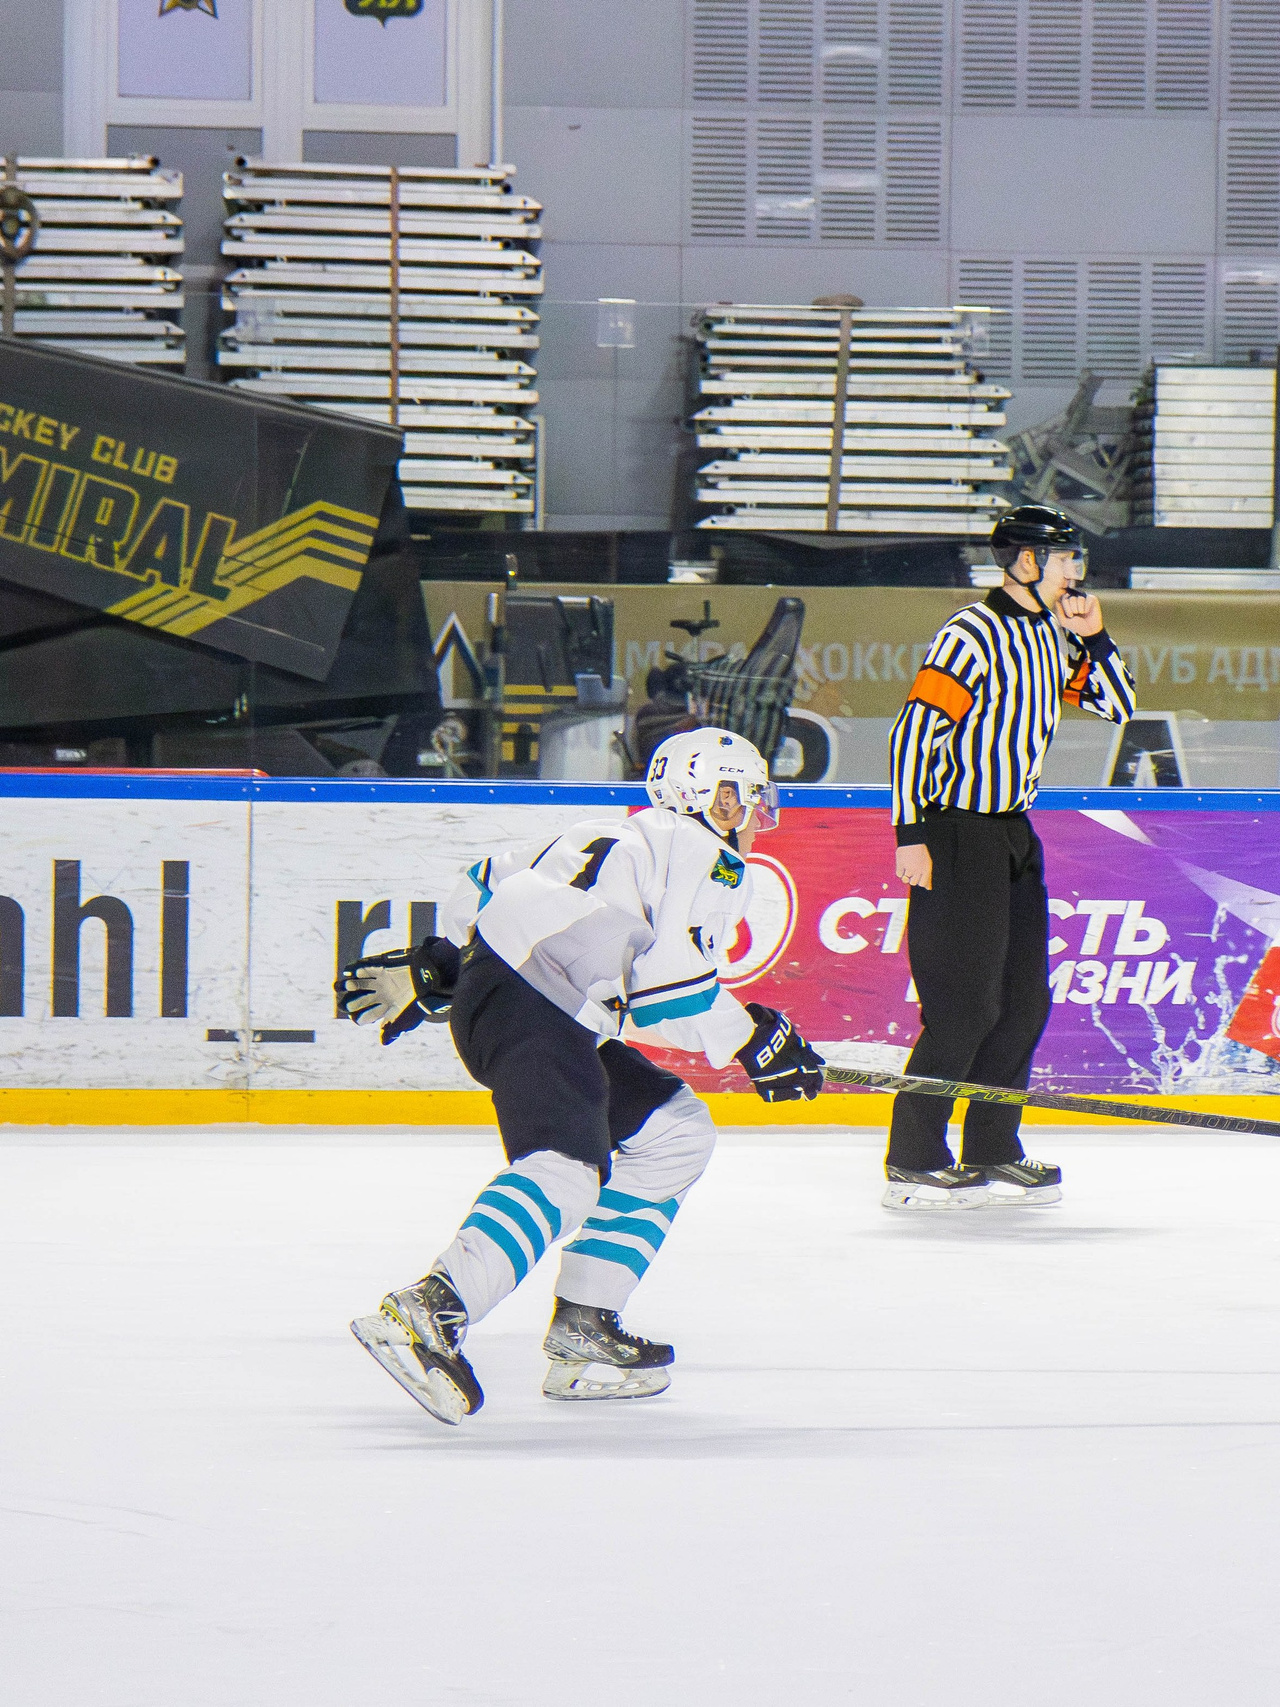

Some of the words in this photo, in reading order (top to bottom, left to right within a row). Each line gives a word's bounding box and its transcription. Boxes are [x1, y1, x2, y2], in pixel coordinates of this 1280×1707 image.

[0, 402, 80, 450] CKEY
[91, 433, 179, 484] CLUB
[0, 446, 238, 602] MIRAL
[1119, 645, 1197, 684] ЛУБ
[718, 766, 745, 774] CCM
[756, 1012, 792, 1069] BAU
